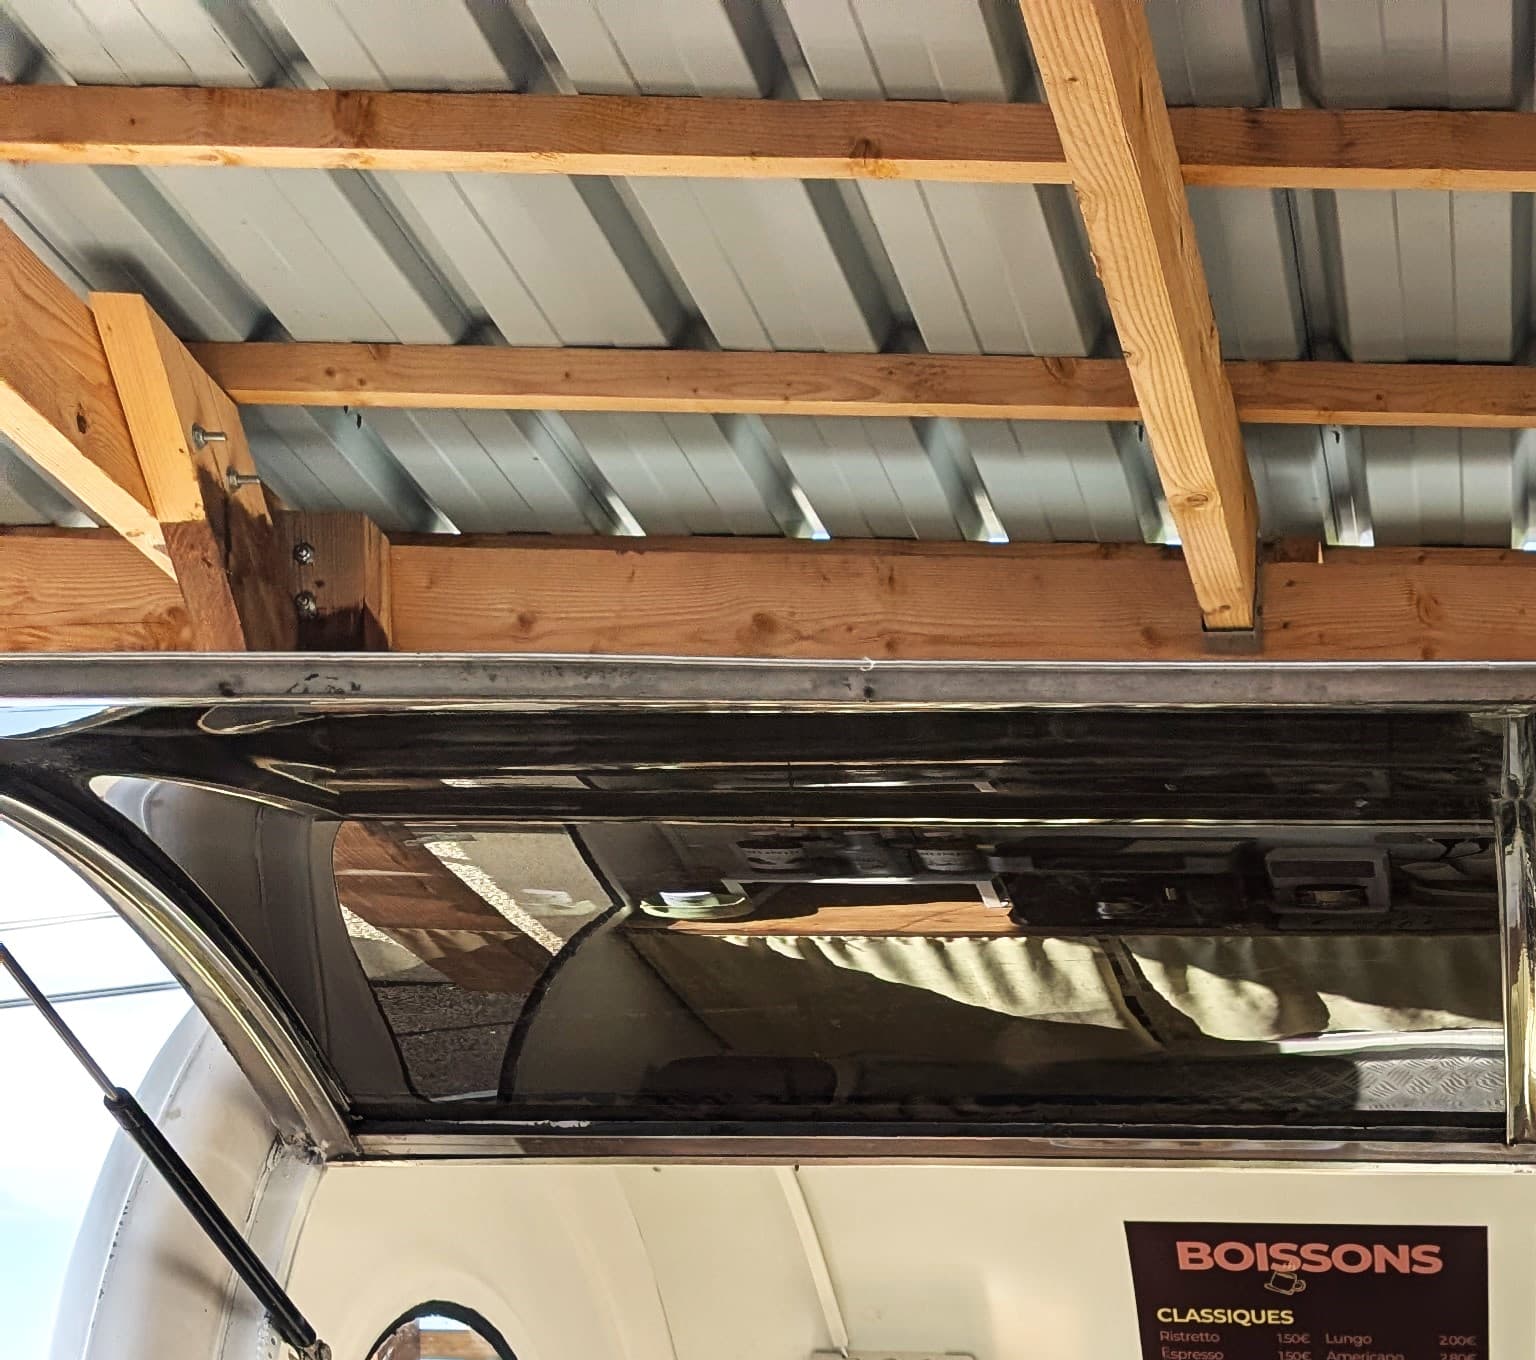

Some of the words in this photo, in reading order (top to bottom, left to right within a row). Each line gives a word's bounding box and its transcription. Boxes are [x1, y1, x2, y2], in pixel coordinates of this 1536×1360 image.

[1175, 1240, 1443, 1274] BOISSONS
[1157, 1308, 1294, 1326] CLASSIQUES
[1160, 1331, 1220, 1342] Ristretto
[1326, 1334, 1372, 1347] Lungo
[1162, 1346, 1224, 1360] Espresso
